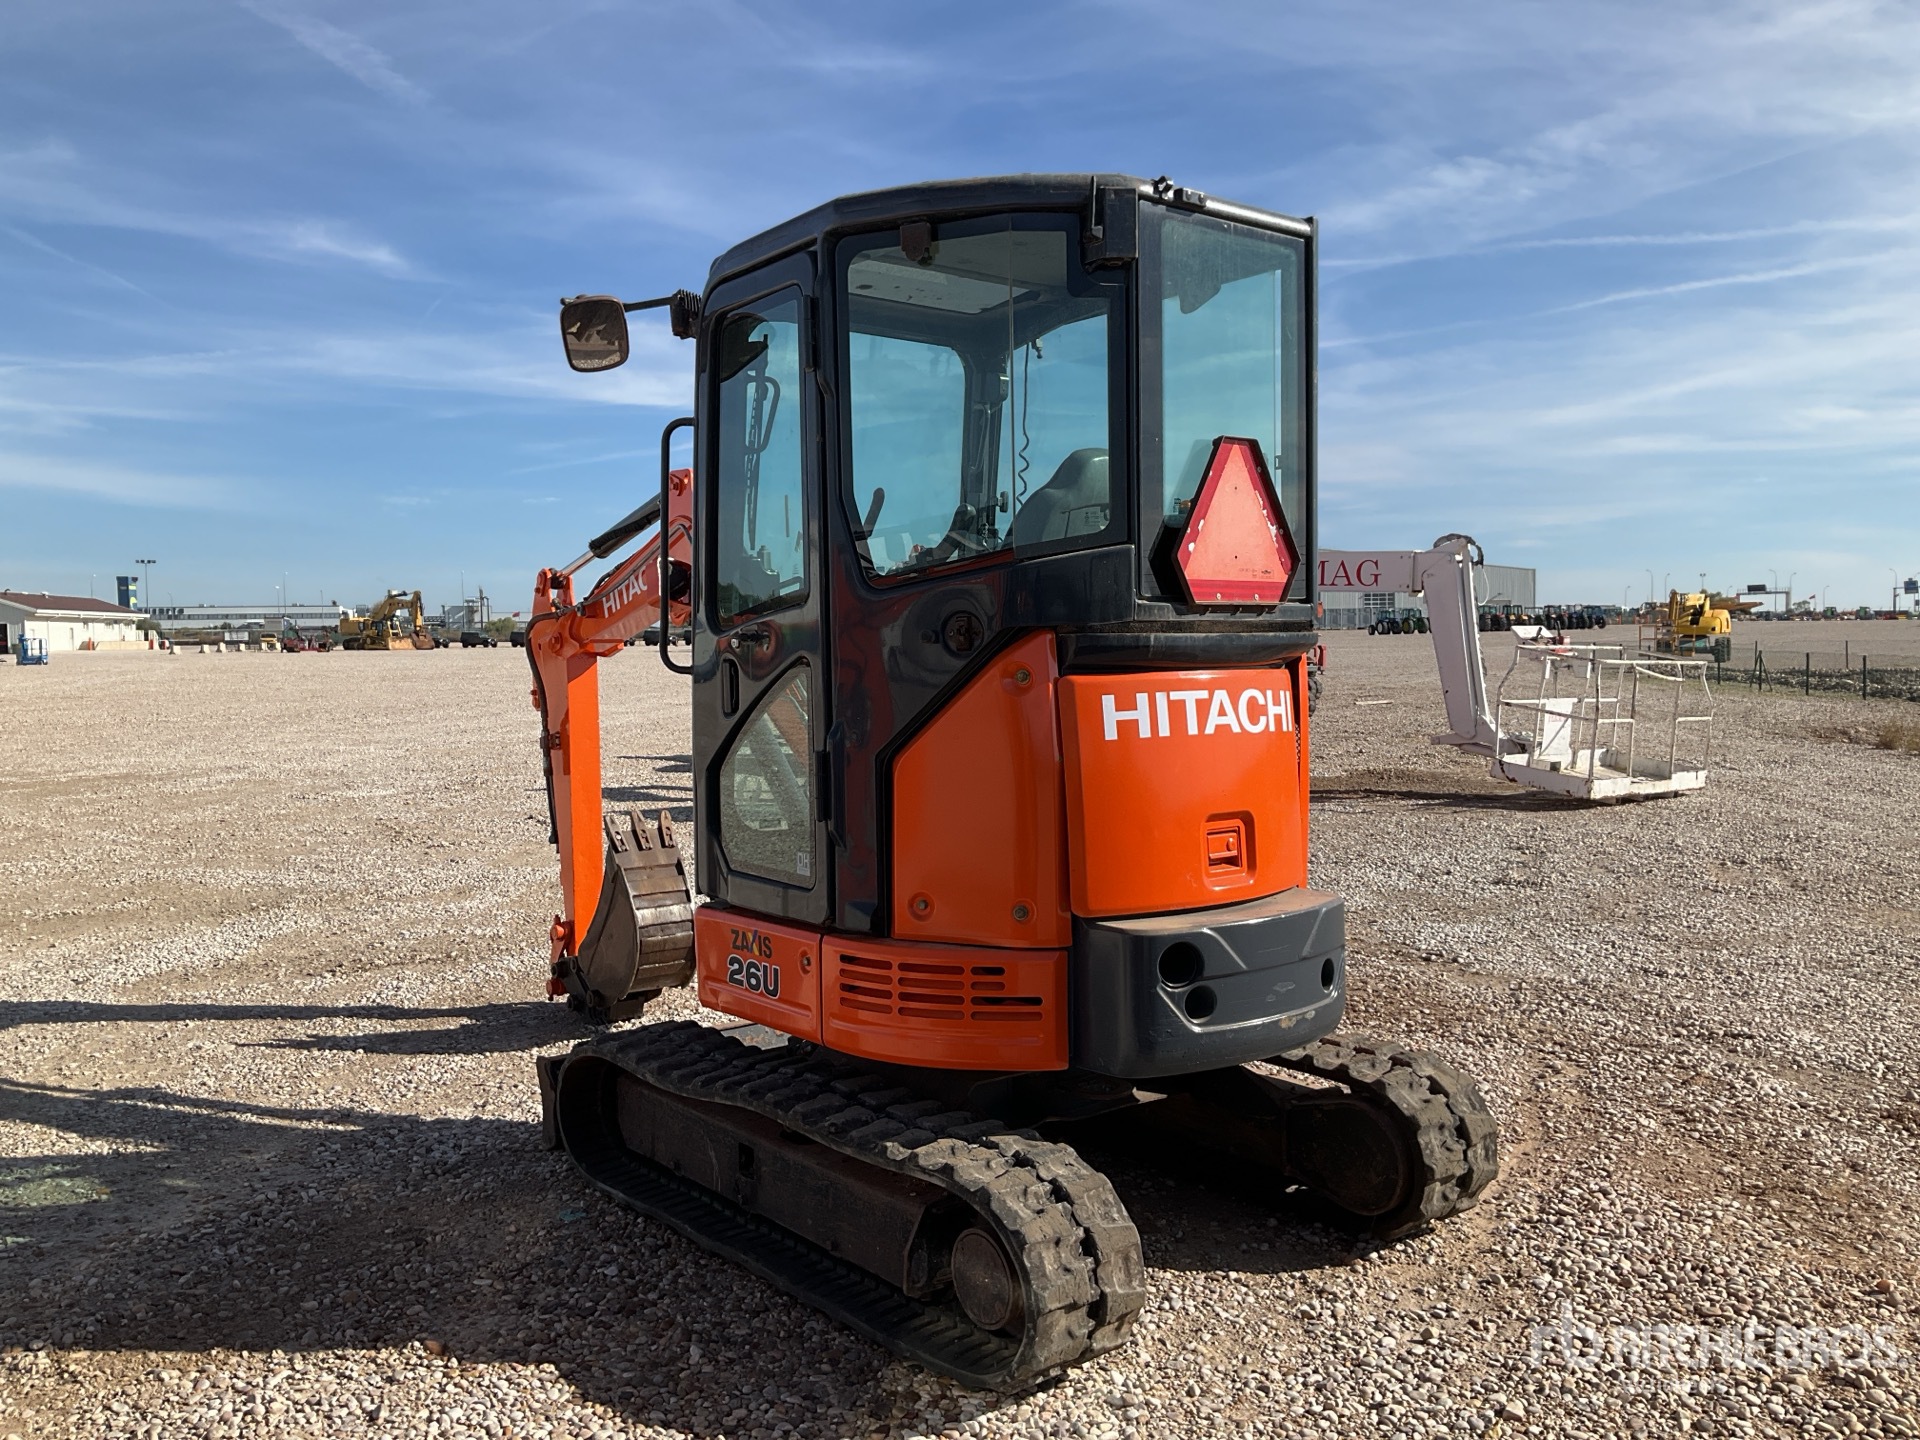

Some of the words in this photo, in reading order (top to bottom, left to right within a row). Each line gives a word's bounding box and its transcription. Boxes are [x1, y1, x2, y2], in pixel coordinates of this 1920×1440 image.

[602, 566, 648, 619] HITAC
[1102, 688, 1293, 741] HITACHI
[731, 930, 773, 959] ZAXIS
[728, 955, 780, 999] 26U
